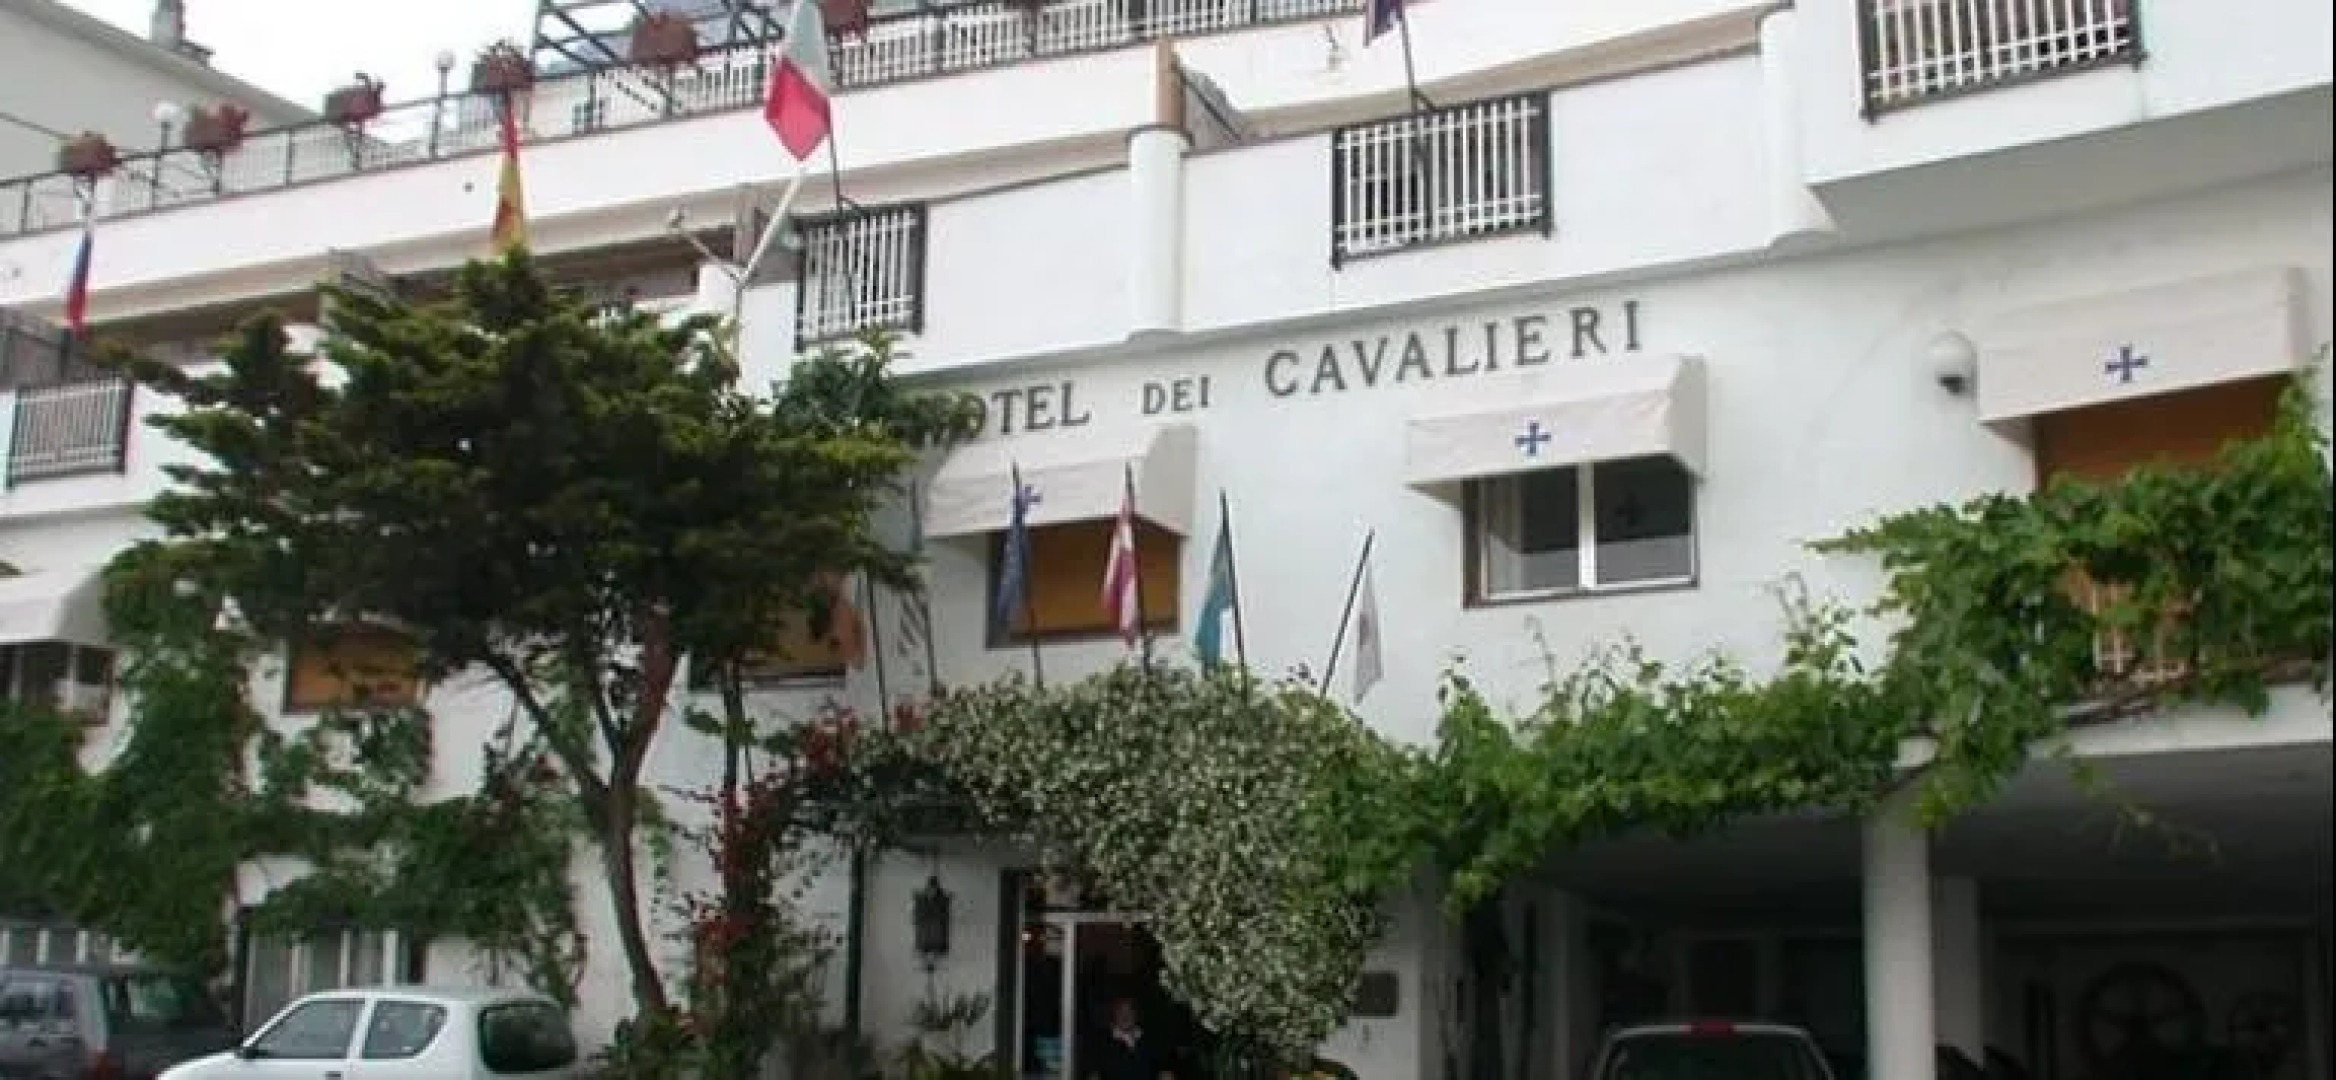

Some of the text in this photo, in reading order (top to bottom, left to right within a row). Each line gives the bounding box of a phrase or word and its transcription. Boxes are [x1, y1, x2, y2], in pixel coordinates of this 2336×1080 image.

[938, 300, 1643, 438] OTEL DEI CAVALIERI
